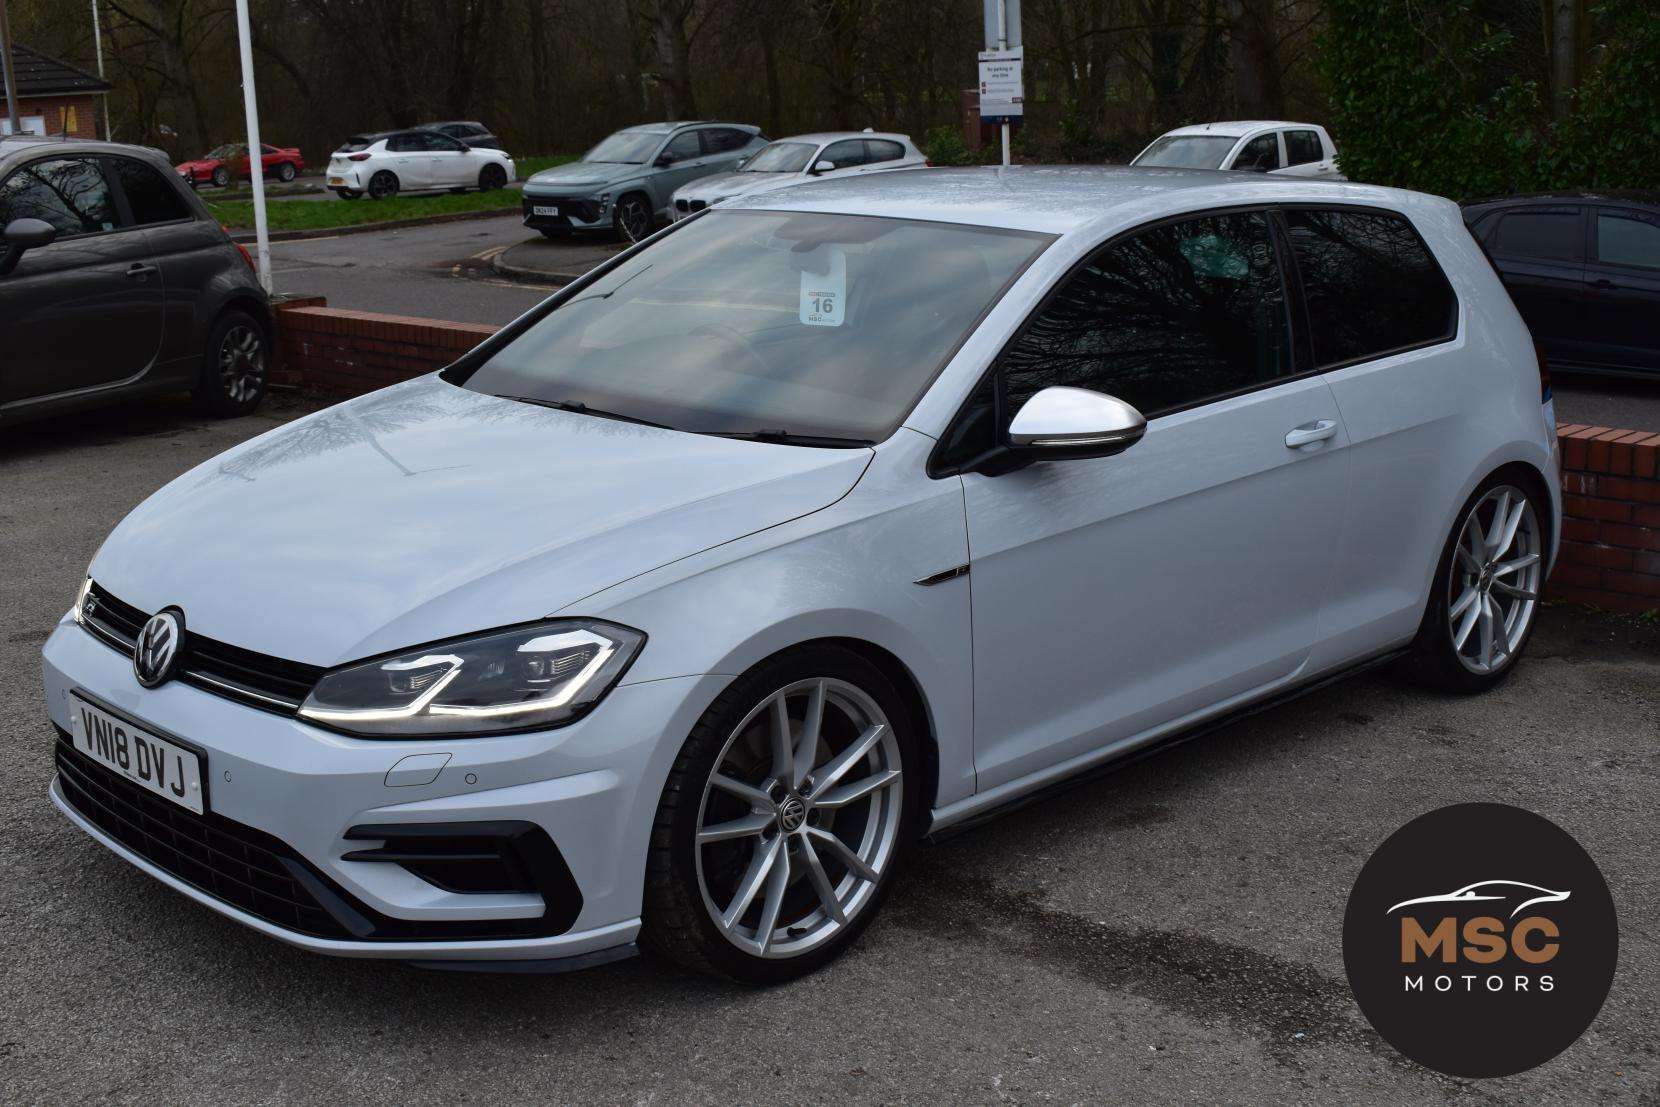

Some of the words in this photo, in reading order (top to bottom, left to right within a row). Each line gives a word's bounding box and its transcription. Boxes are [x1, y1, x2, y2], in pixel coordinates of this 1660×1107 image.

[812, 298, 833, 313] 16
[81, 707, 130, 771] VN18
[134, 736, 185, 798] DVJ
